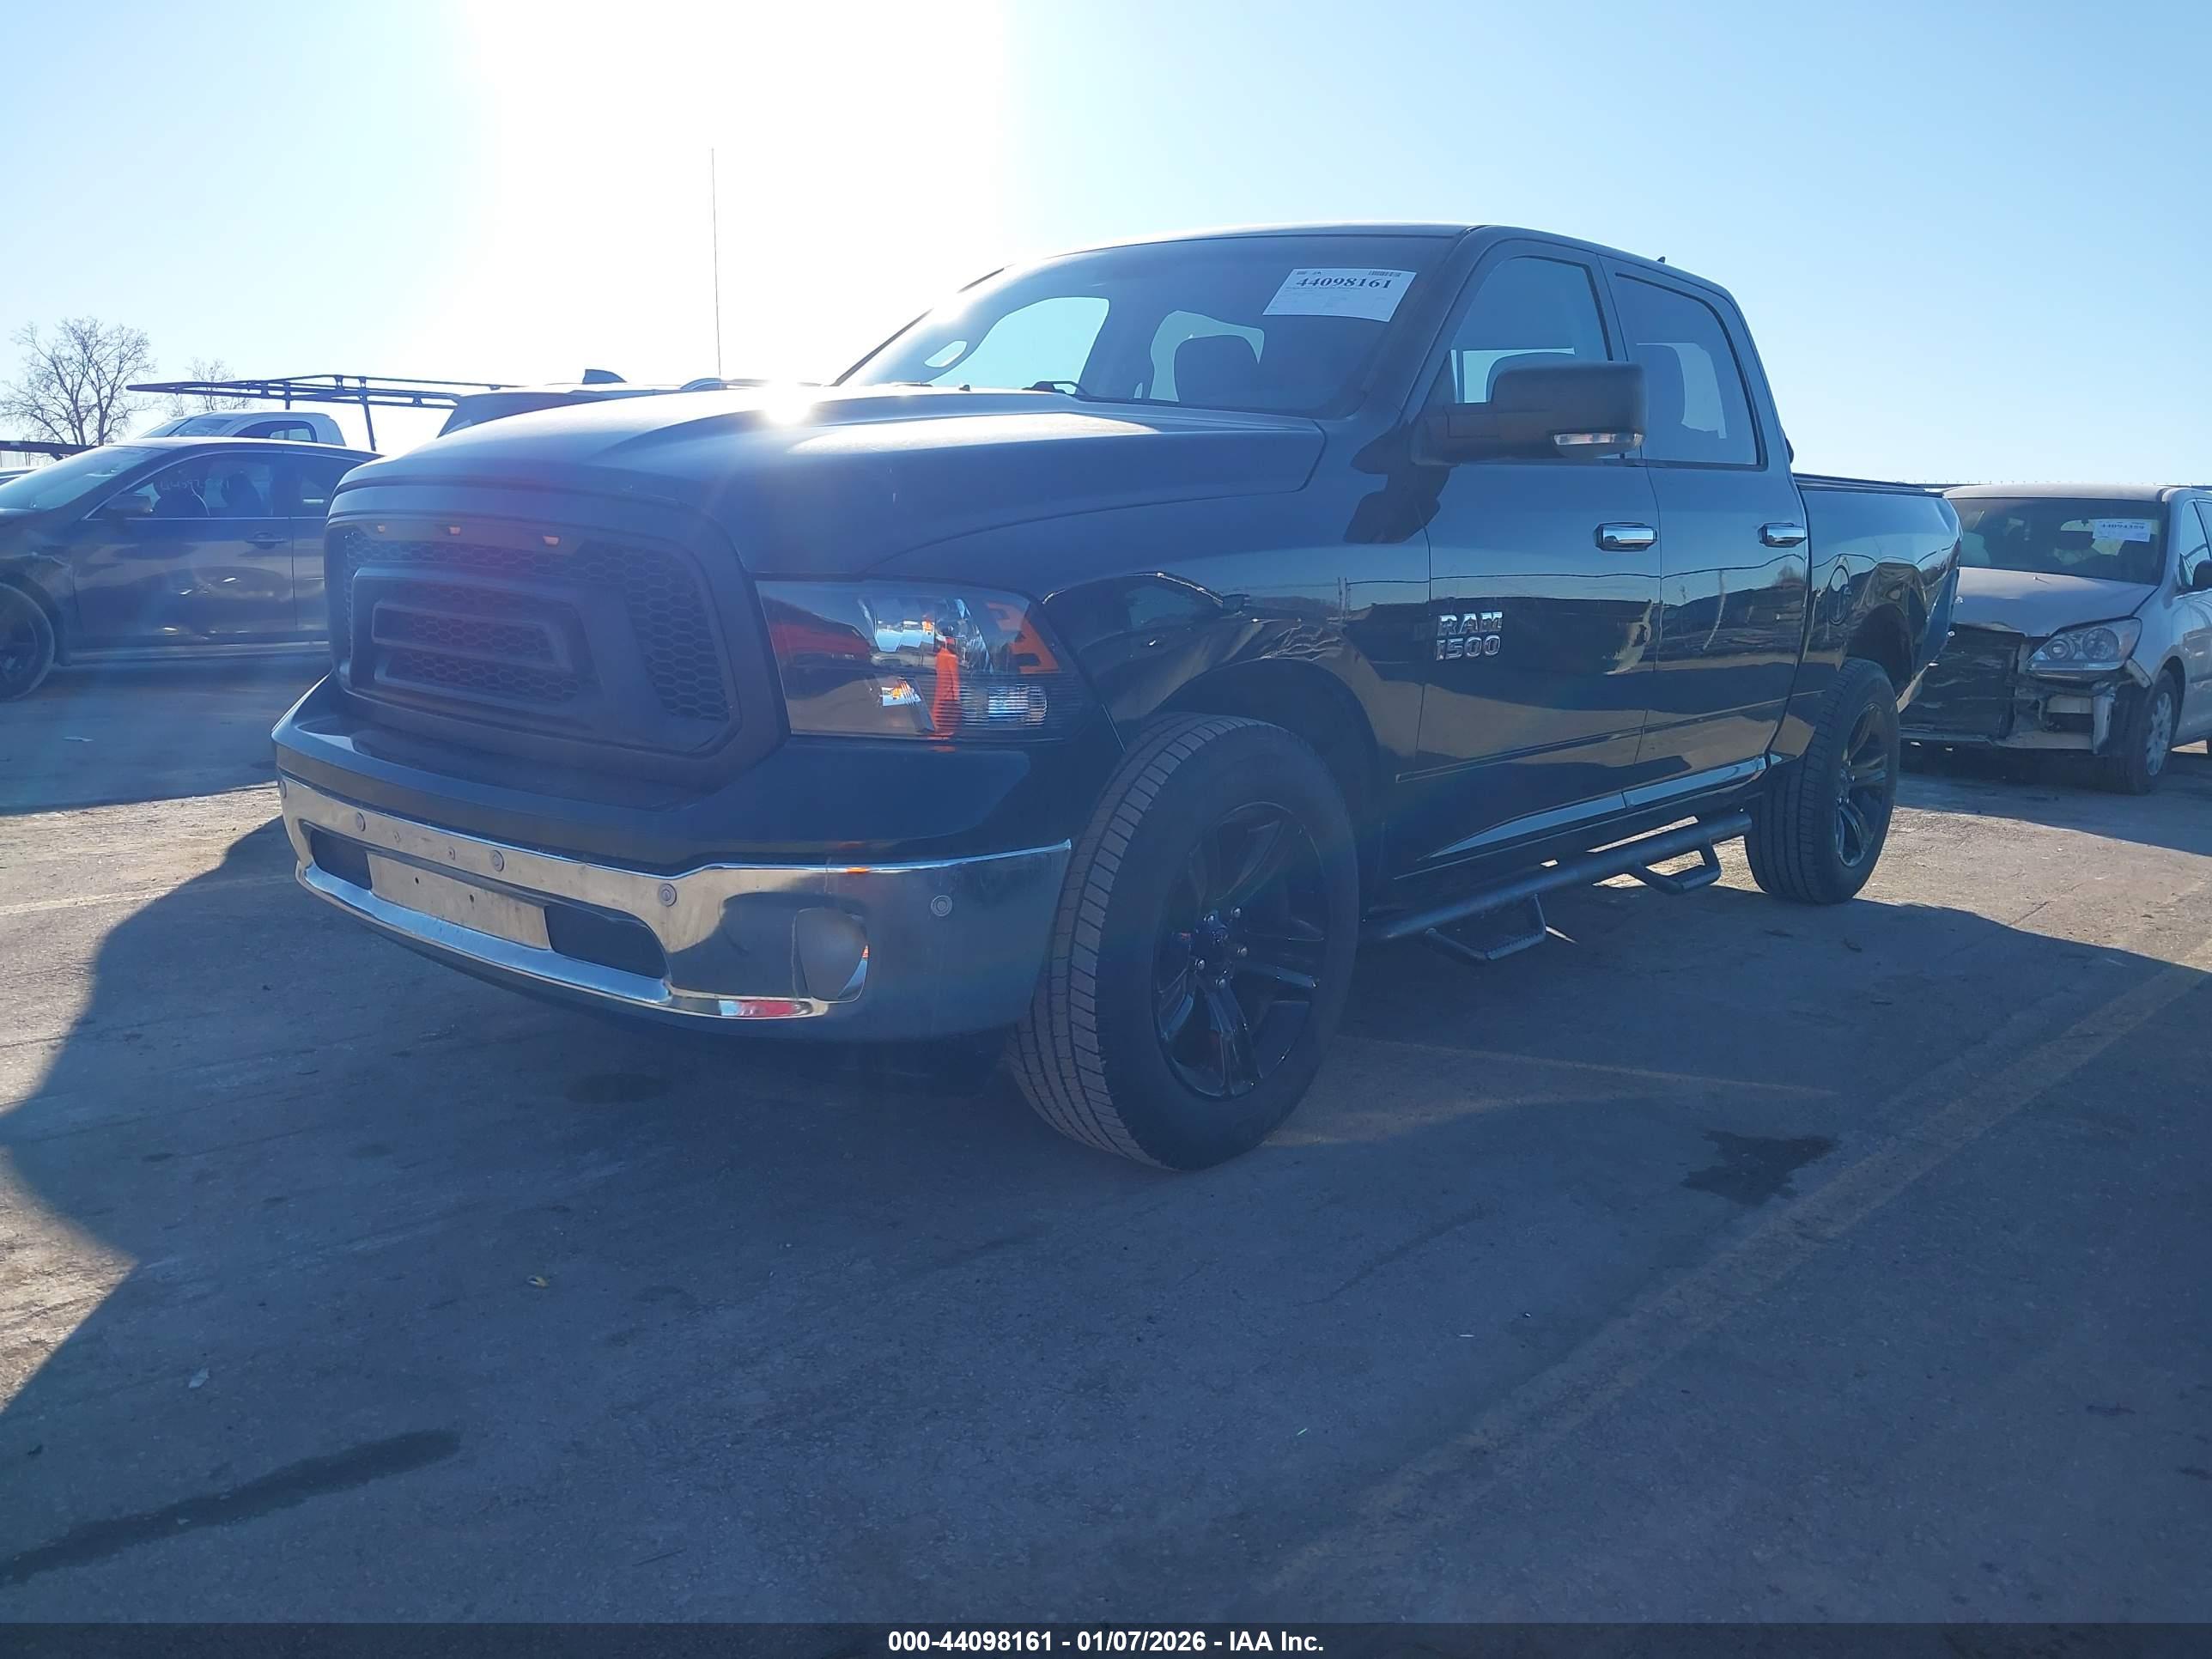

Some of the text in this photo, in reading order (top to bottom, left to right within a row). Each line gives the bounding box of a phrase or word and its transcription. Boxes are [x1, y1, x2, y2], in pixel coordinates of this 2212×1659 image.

[1296, 276, 1393, 289] 44098161
[1437, 611, 1504, 636] RAM
[1436, 634, 1502, 660] 1500
